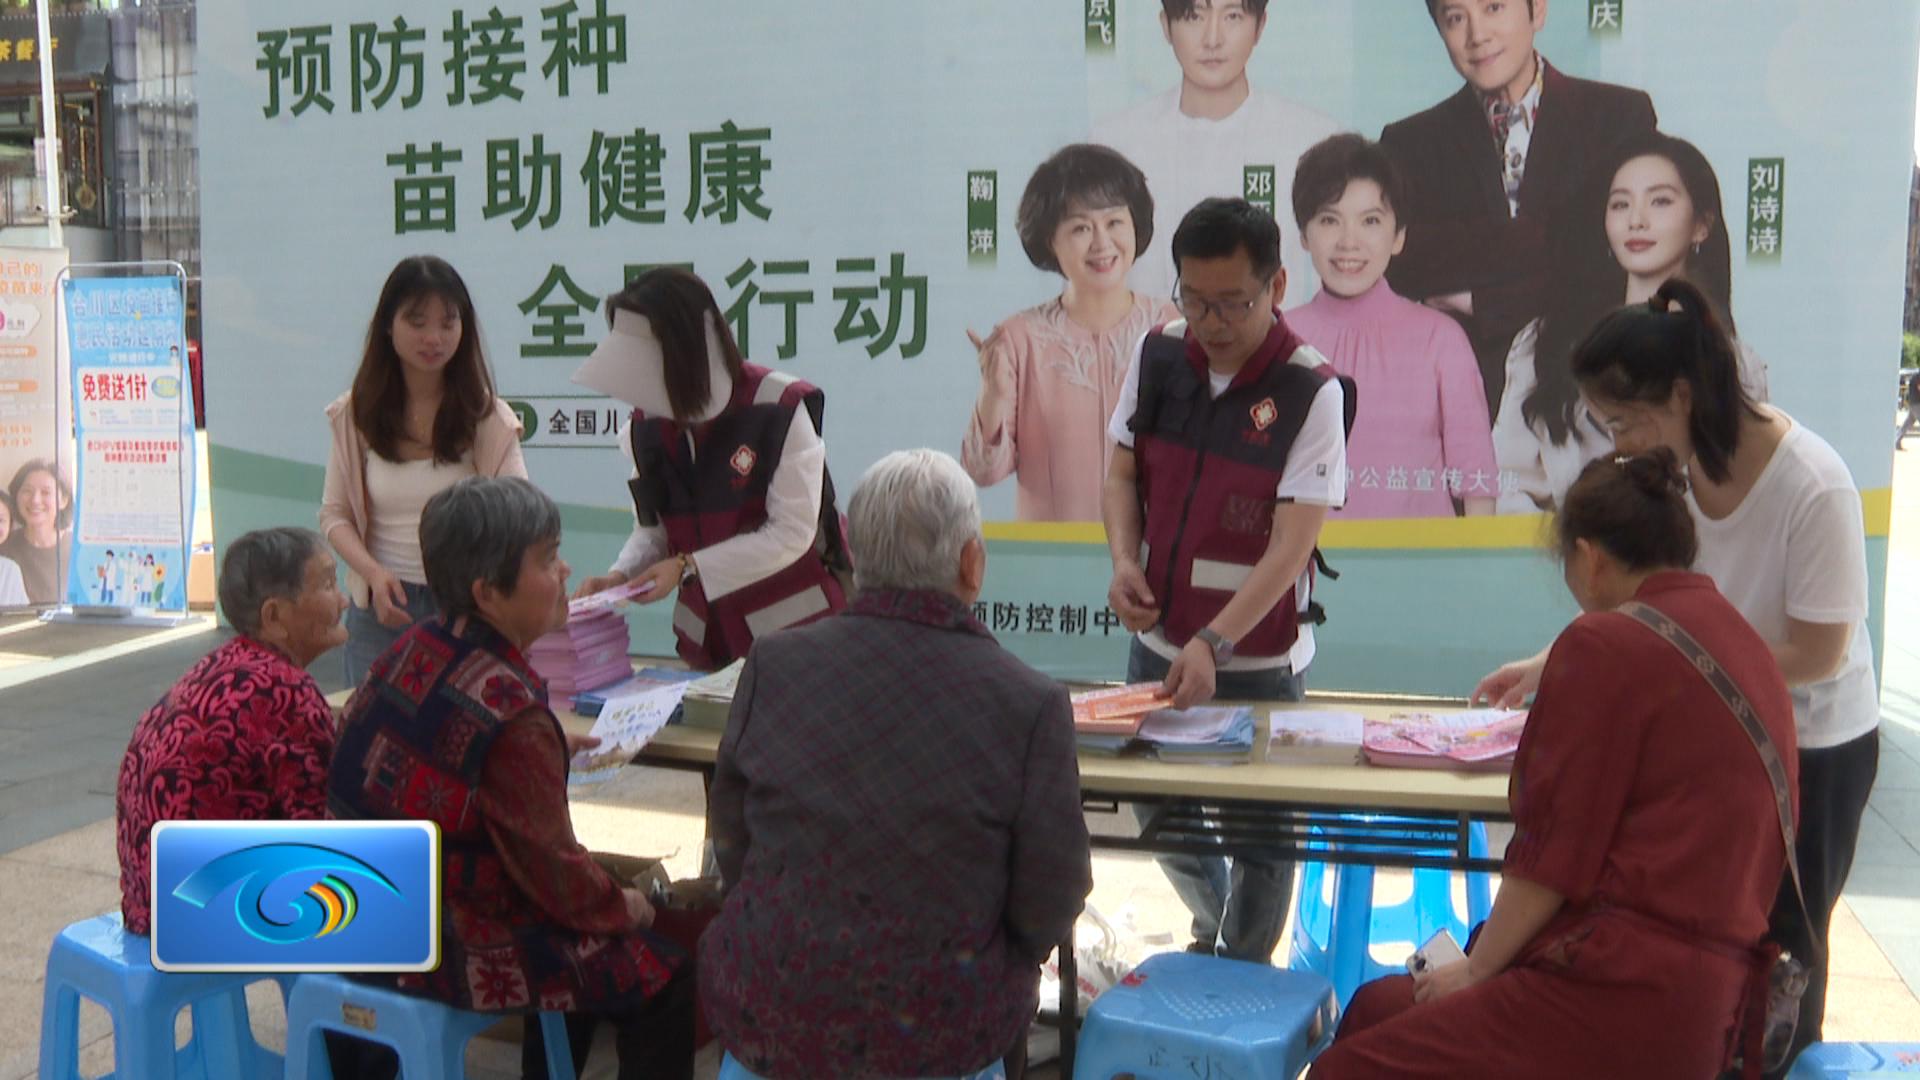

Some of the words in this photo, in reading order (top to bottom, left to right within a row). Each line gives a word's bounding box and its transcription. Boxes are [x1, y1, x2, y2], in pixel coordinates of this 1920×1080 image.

[256, 0, 628, 119] 预防接种
[1591, 1, 1619, 29] 庆
[387, 120, 773, 235] 苗助健康
[970, 175, 994, 254] 鞠萍
[1750, 163, 1780, 255] 刘诗诗
[517, 252, 929, 360] 全行动
[82, 374, 148, 401] 免费送1针
